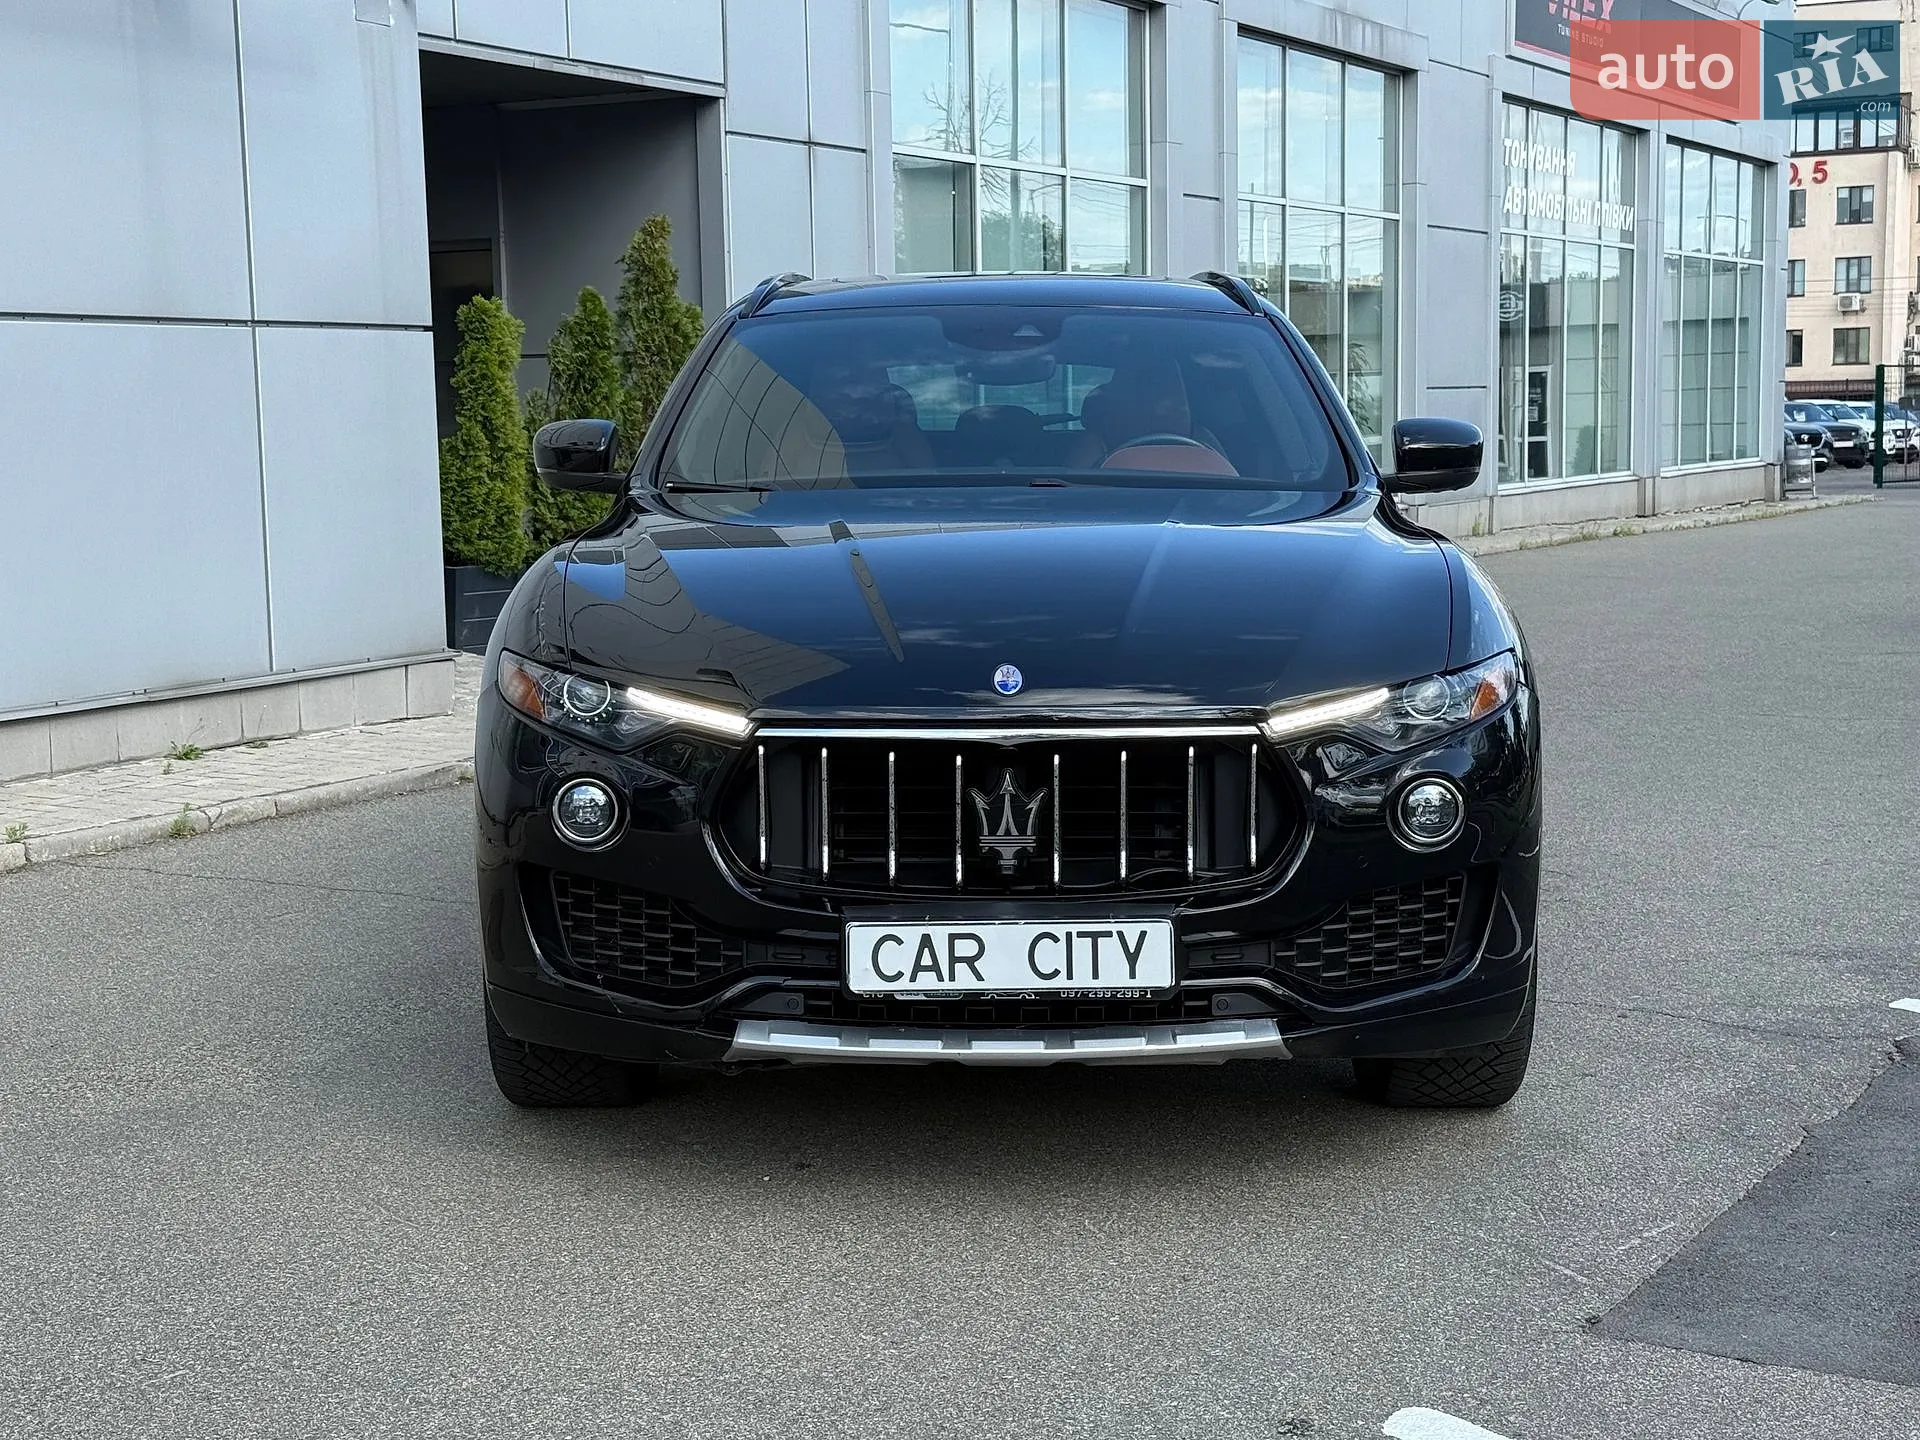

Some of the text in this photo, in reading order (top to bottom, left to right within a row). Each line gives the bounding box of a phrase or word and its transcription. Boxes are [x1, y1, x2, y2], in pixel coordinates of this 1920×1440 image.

[1812, 160, 1828, 184] 5
[871, 930, 1148, 983] CAR CITY
